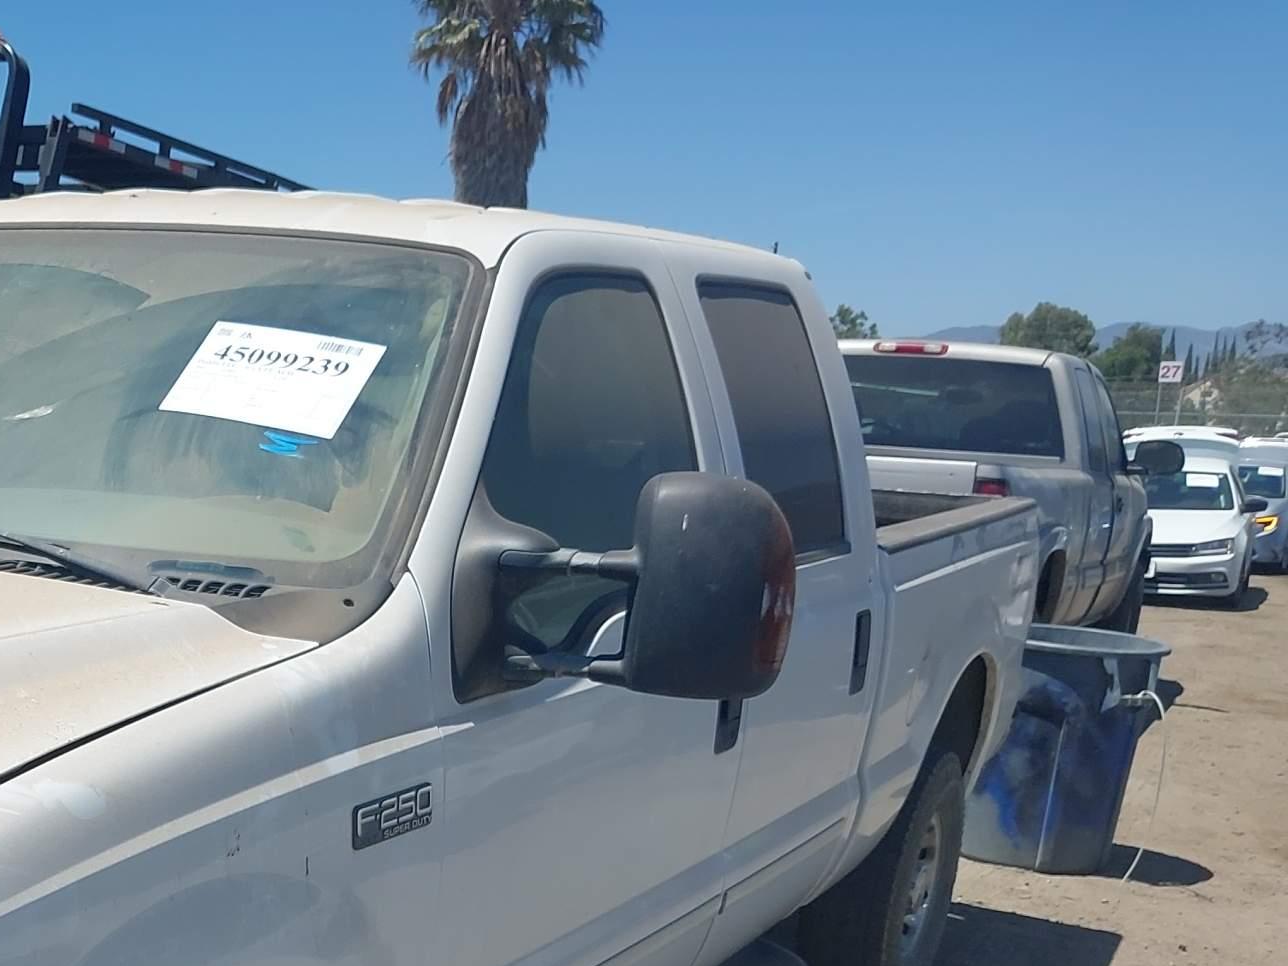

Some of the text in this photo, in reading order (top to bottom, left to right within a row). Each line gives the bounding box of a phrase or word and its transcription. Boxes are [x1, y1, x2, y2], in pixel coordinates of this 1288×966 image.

[214, 345, 350, 377] 45099239
[1160, 365, 1181, 379] 27
[383, 815, 432, 839] SUPER DUTY
